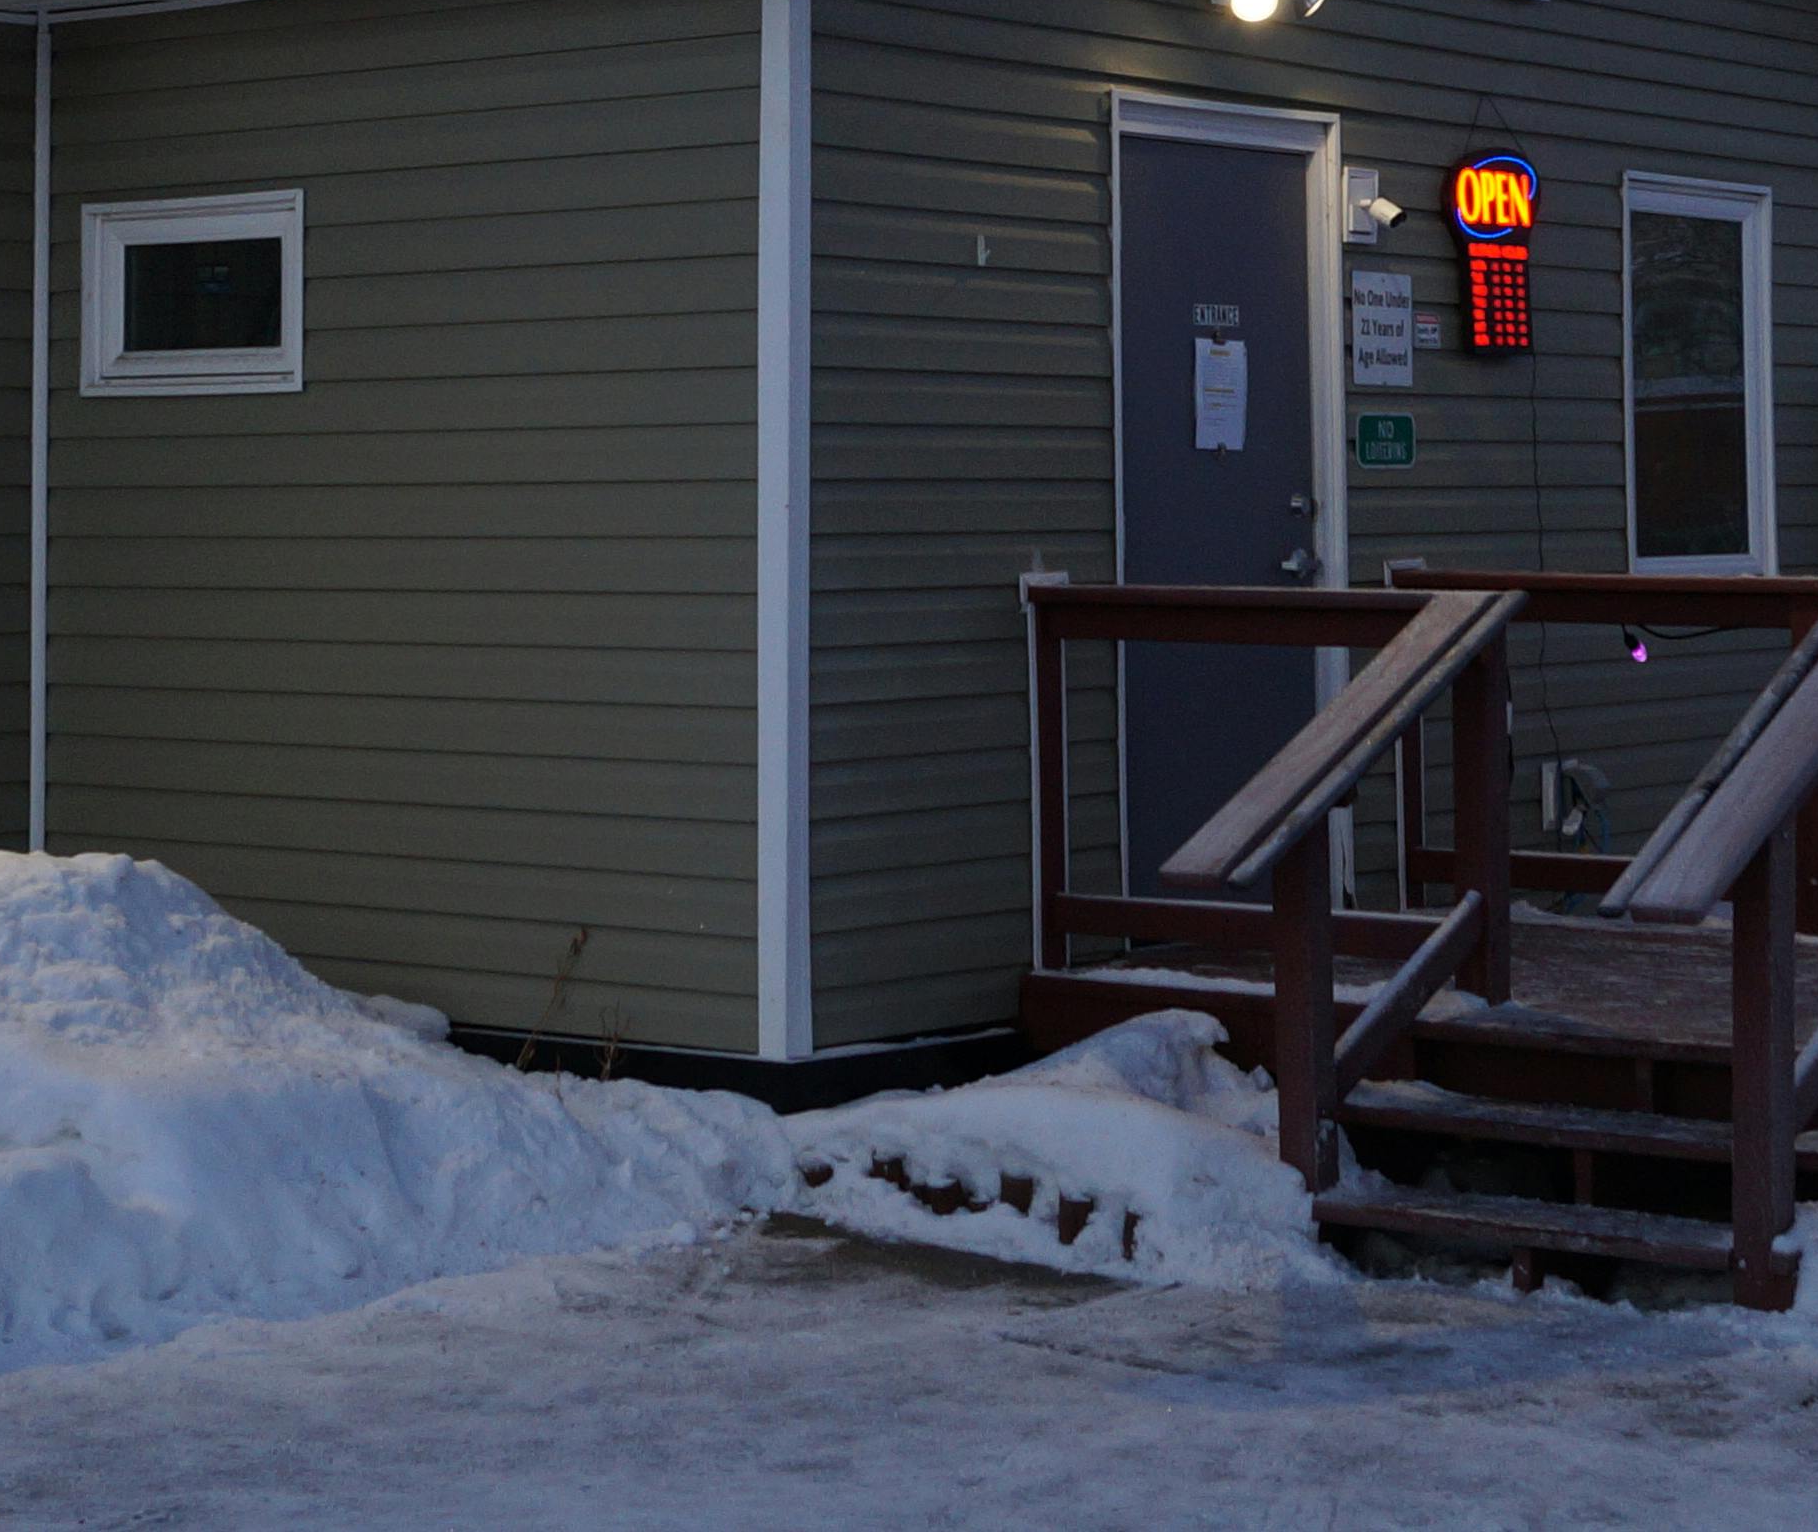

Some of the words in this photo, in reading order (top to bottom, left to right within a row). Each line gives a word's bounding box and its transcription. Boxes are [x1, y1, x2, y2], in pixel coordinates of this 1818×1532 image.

[1456, 167, 1531, 227] OPEN
[1354, 288, 1366, 305] No
[1368, 290, 1384, 306] One
[1386, 290, 1411, 308] Under
[1194, 305, 1238, 325] ENTRANCE
[1372, 318, 1394, 337] Years
[1396, 318, 1405, 337] of
[1358, 347, 1374, 368] Age
[1376, 347, 1408, 367] Allowed
[1377, 419, 1395, 439] NO
